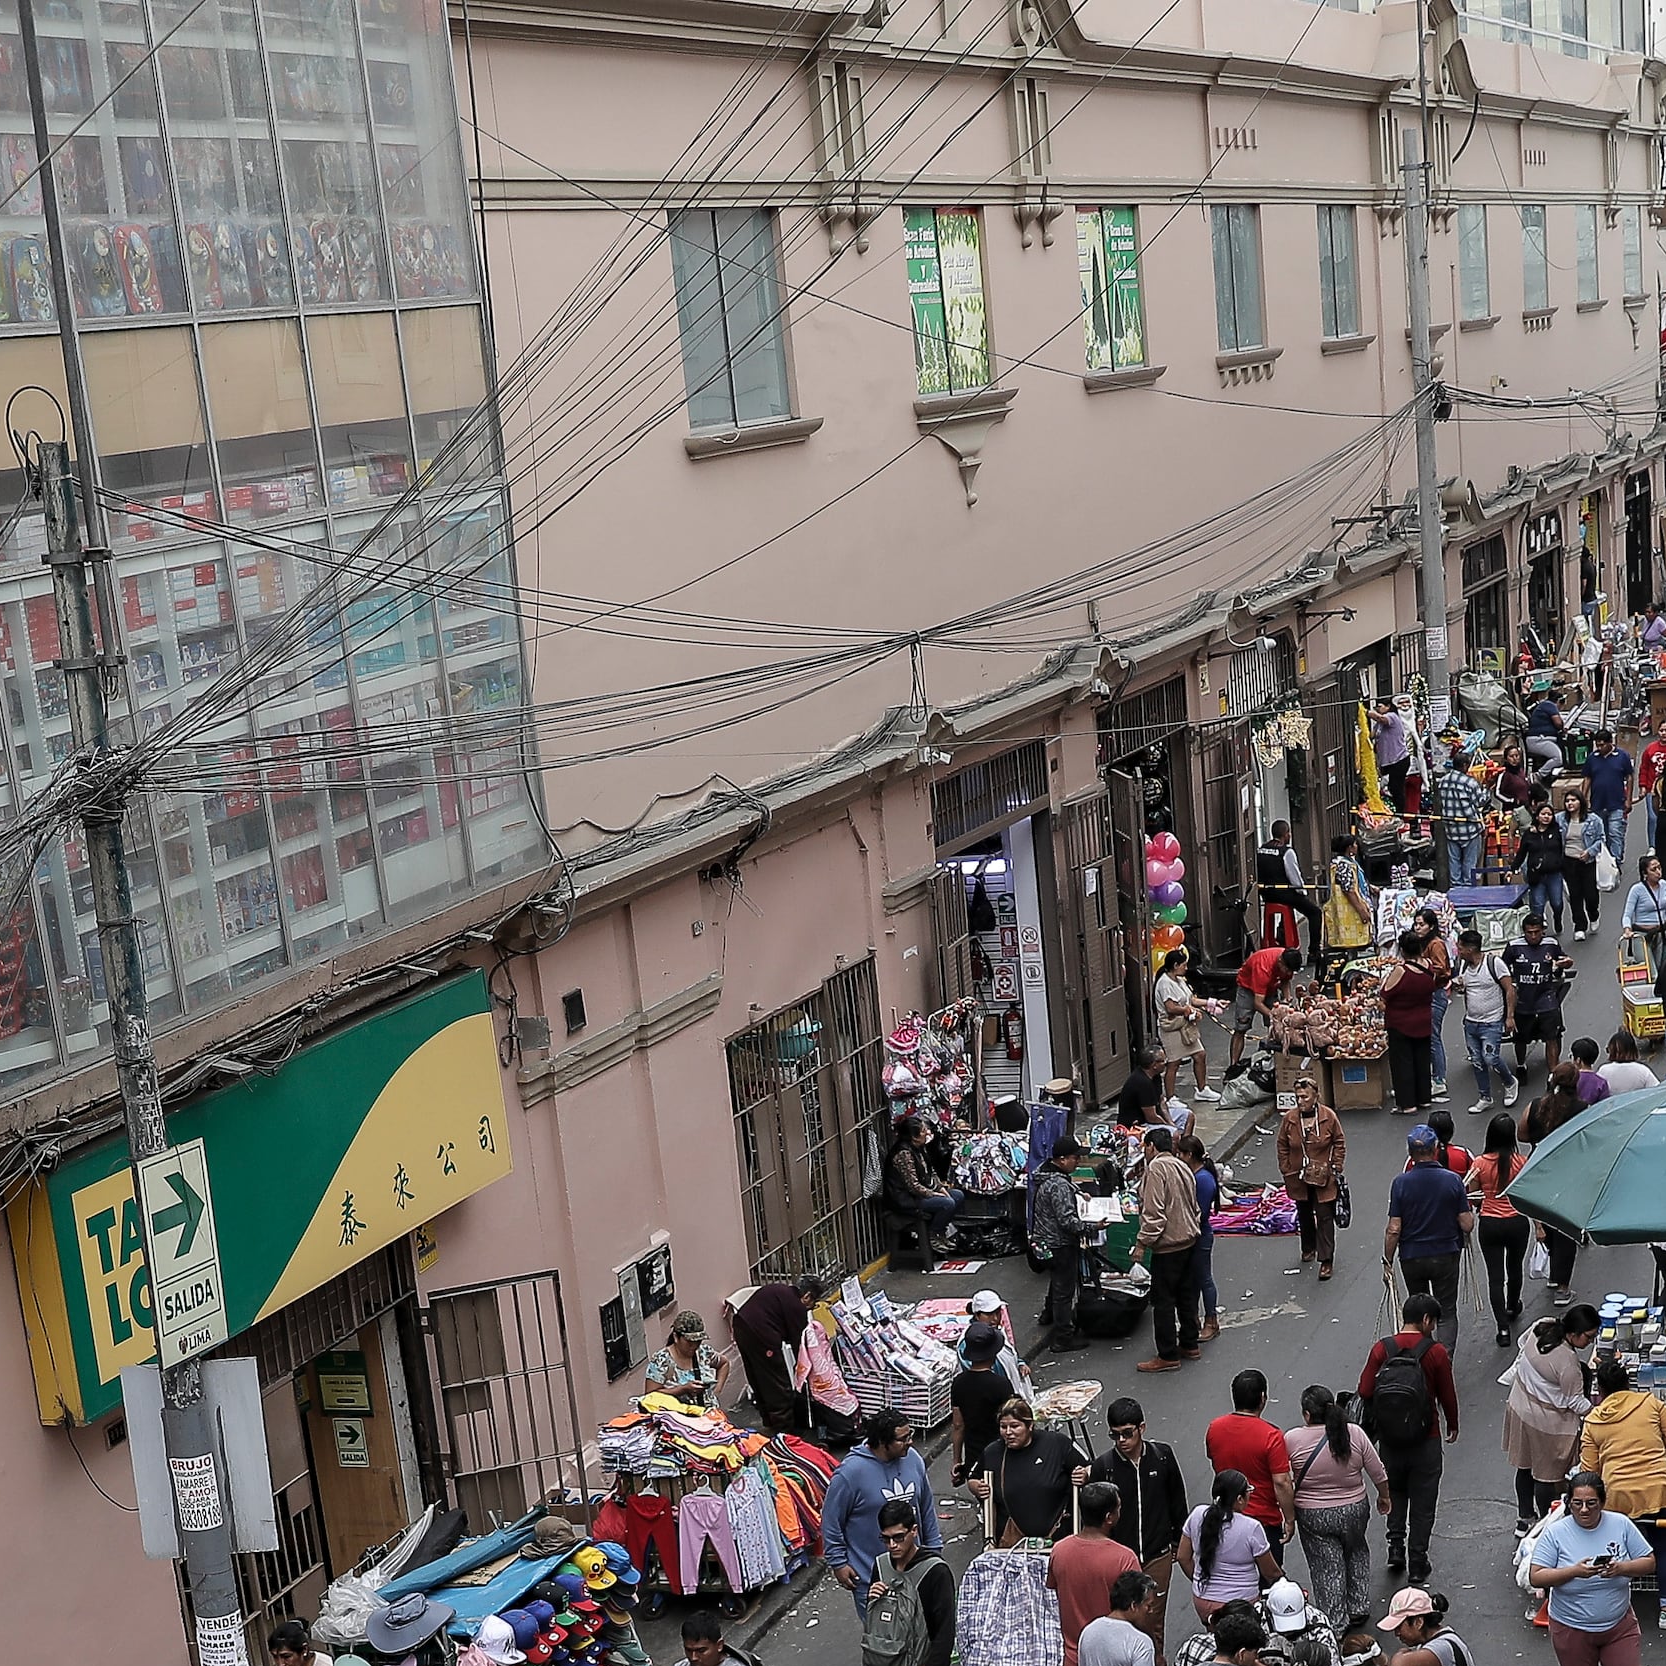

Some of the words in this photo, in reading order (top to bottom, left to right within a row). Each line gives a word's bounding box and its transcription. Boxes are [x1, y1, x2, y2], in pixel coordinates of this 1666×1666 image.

[164, 1278, 215, 1321] SALIDA
[188, 1329, 212, 1351] LIMA
[341, 1453, 366, 1462] SALIDA
[171, 1457, 211, 1471] BRUJO
[181, 1476, 208, 1488] AMARRE
[189, 1485, 216, 1498] AMOR
[199, 1632, 232, 1640] ALQUILO
[199, 1640, 235, 1649] ALMACEN
